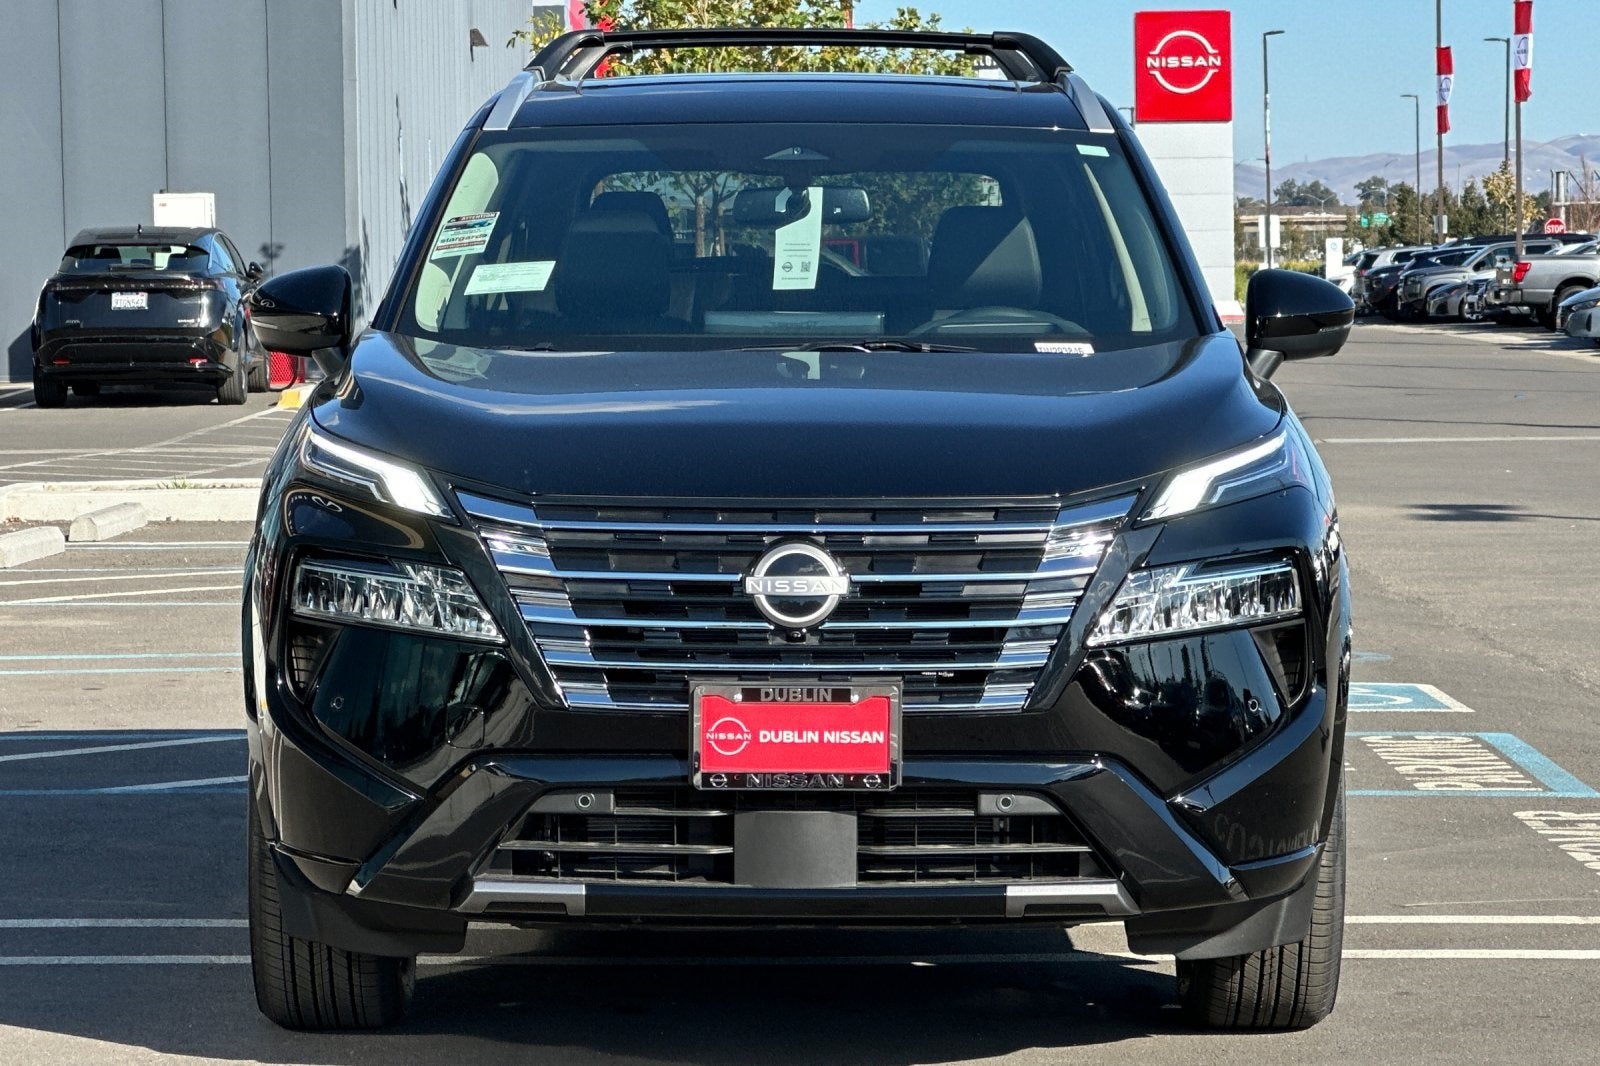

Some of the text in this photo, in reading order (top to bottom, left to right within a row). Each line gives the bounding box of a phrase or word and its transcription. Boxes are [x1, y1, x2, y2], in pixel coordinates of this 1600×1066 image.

[1146, 55, 1221, 69] NISSAN
[1546, 225, 1564, 234] STOP
[748, 580, 845, 593] NISSAN
[760, 688, 832, 702] DUBLIN
[705, 732, 752, 741] NISSAN
[759, 730, 885, 744] DUBLIN NISSAN
[746, 773, 845, 788] NISSAN
